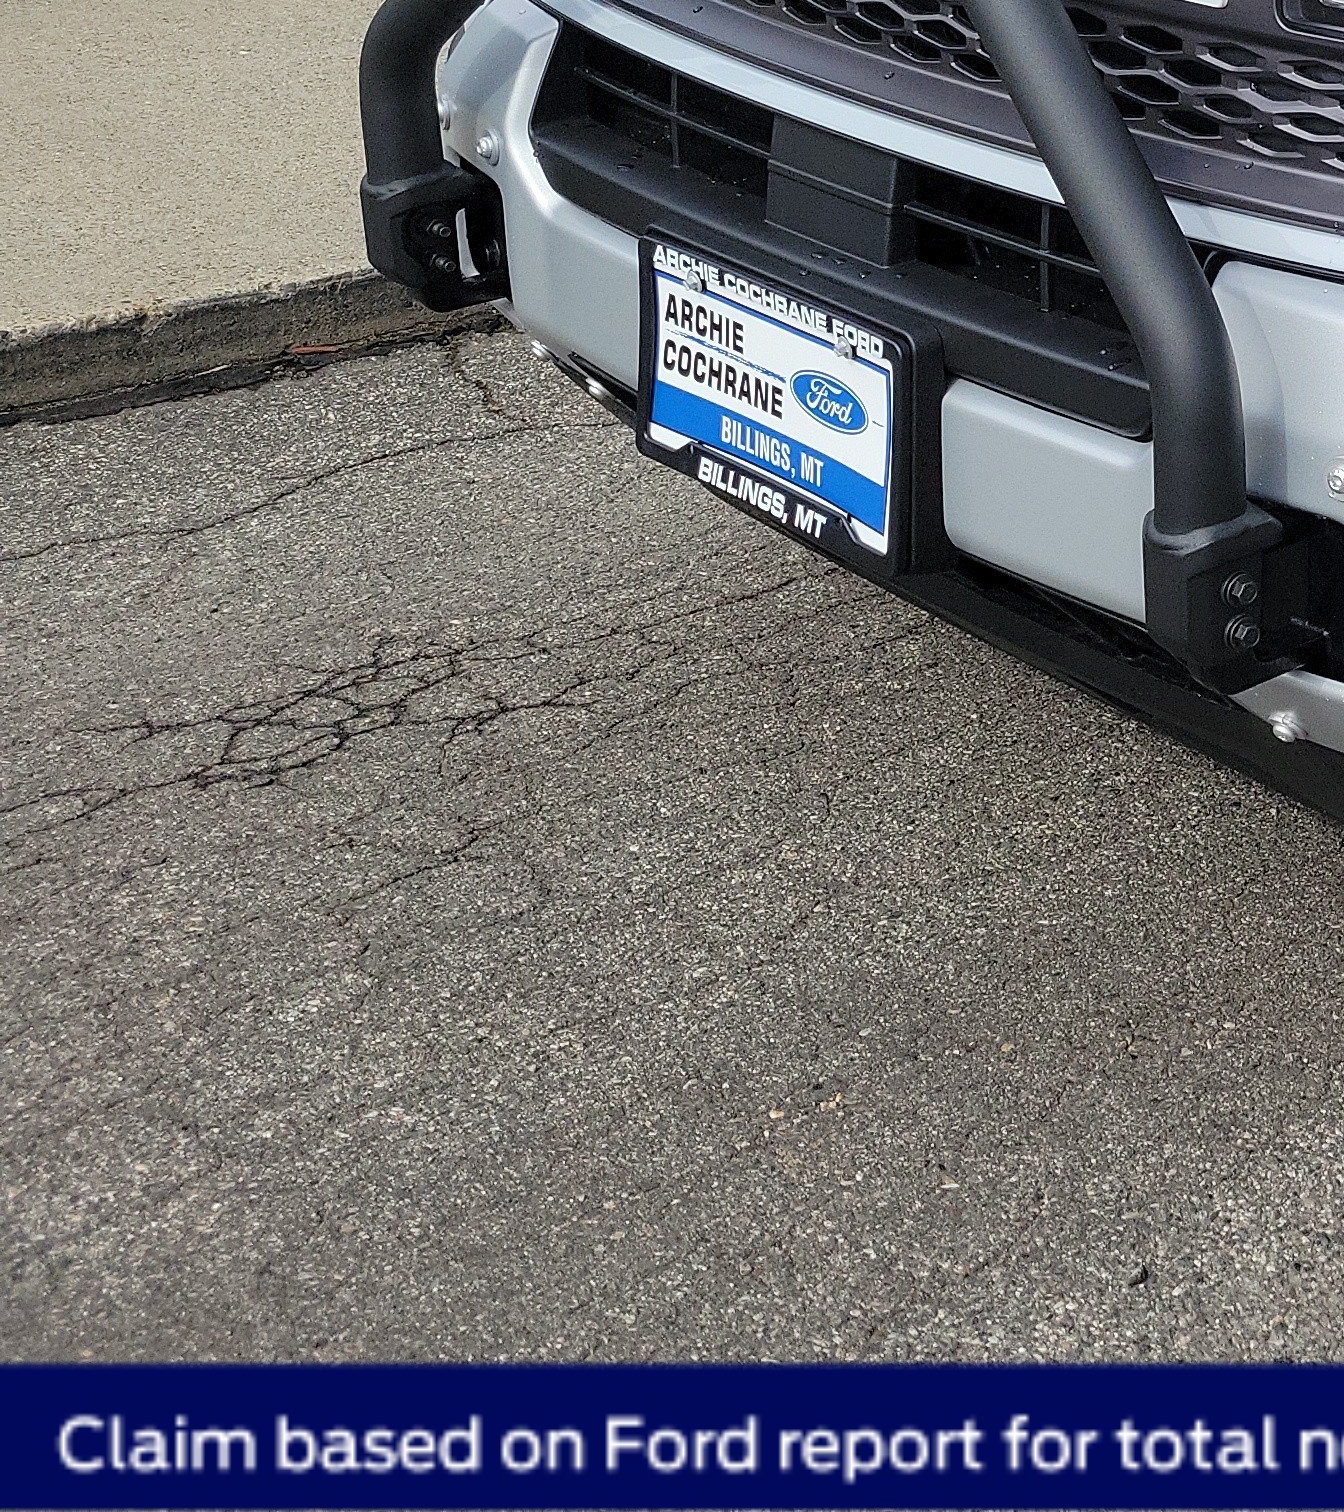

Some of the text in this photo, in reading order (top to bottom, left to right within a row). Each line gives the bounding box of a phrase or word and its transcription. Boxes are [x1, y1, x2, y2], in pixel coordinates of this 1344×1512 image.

[652, 244, 885, 360] ARCHIE COCHRANE FORD
[664, 292, 744, 355] ARCHIE
[663, 339, 784, 420] COCHRANE
[806, 378, 852, 426] Ford
[721, 415, 825, 487] BILLINGS, MT
[697, 456, 828, 539] BILLINGS, MT
